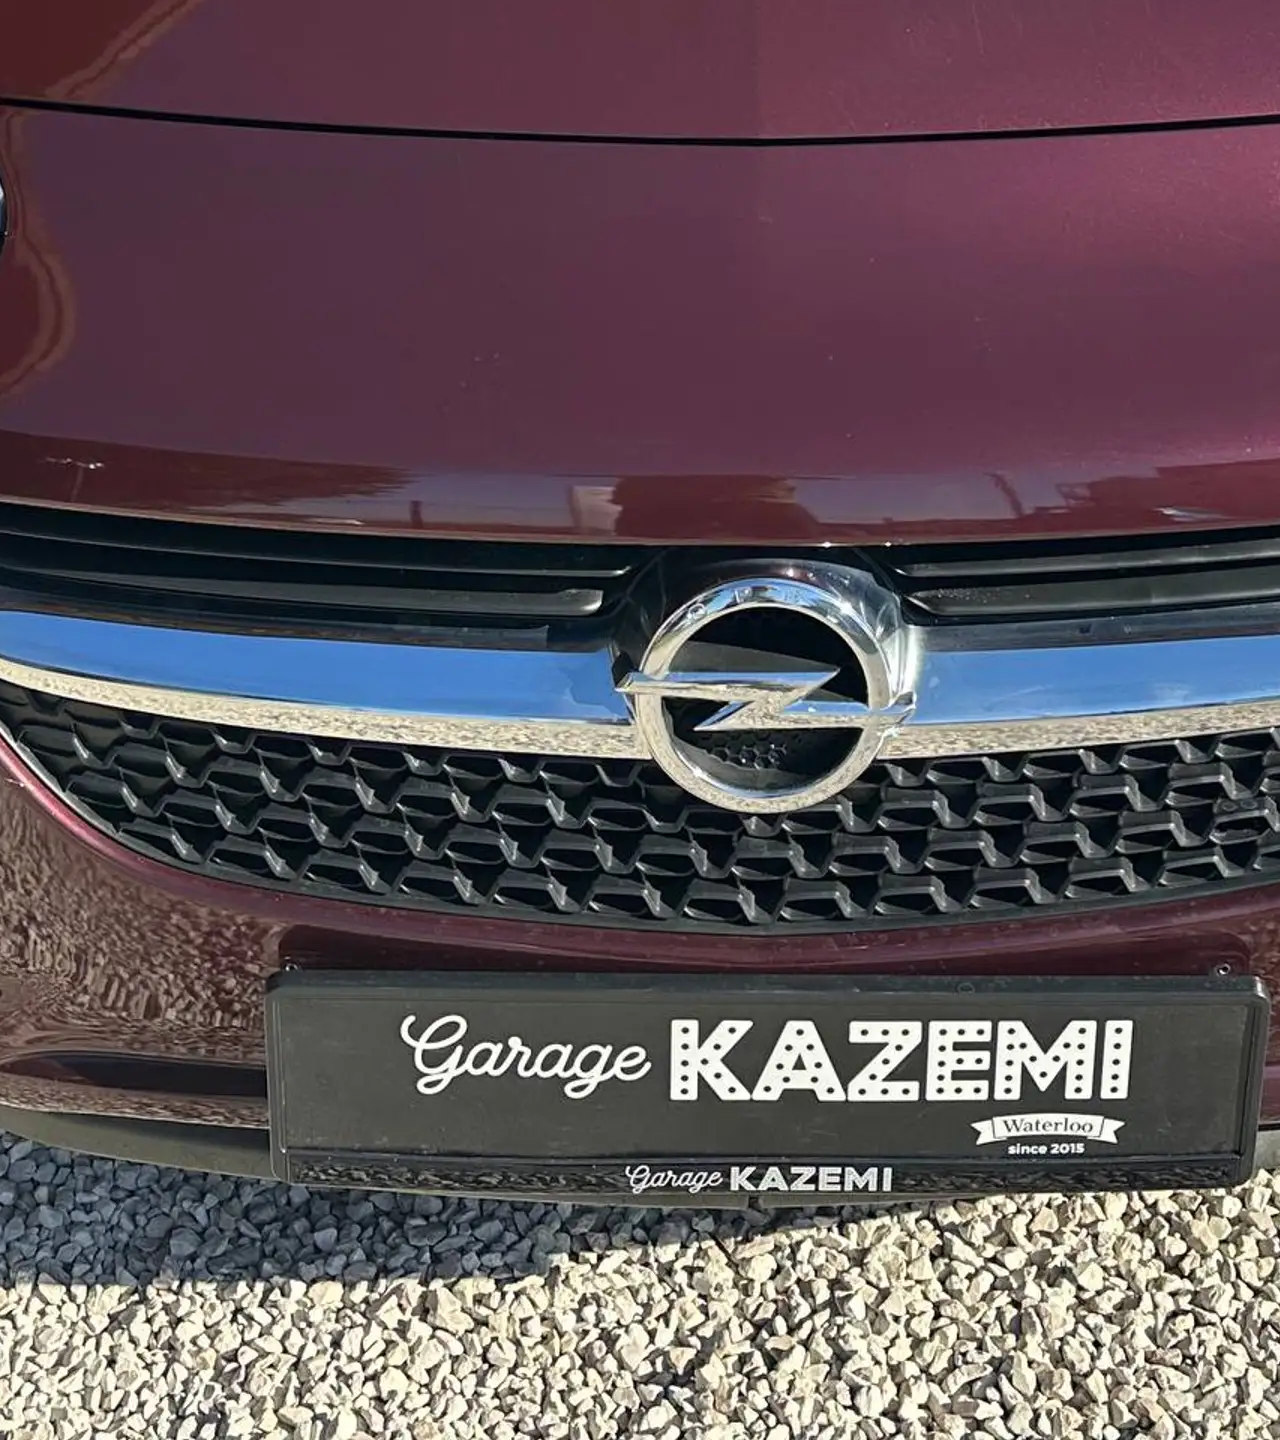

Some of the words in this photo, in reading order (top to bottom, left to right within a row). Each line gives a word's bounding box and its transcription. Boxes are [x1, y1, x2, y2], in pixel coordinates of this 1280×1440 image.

[400, 1014, 652, 1099] Garage
[669, 1019, 1134, 1101] KAZEMI
[1002, 1117, 1094, 1134] Waterloo
[1007, 1142, 1047, 1155] since
[1050, 1142, 1085, 1155] 2015
[625, 1164, 723, 1194] Garage
[729, 1165, 893, 1192] KAZEMI
